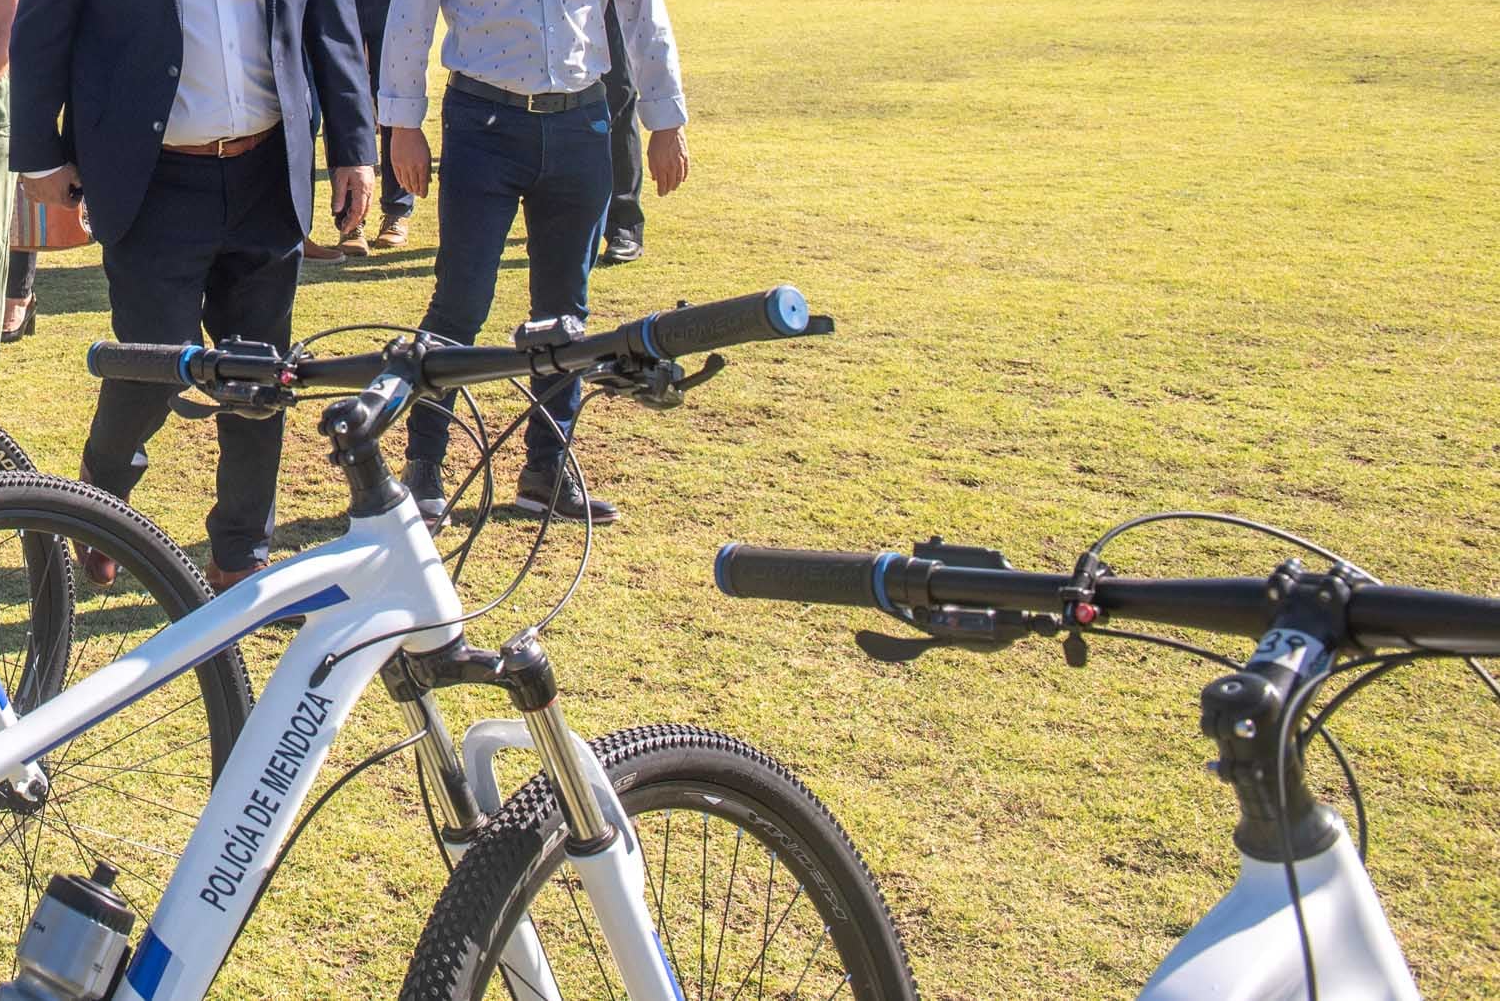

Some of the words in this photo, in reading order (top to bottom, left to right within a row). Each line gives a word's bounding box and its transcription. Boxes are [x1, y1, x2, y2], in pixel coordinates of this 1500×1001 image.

[259, 692, 333, 796] MENDOZA
[243, 789, 280, 828] DE
[200, 825, 265, 912] POLICÍA
